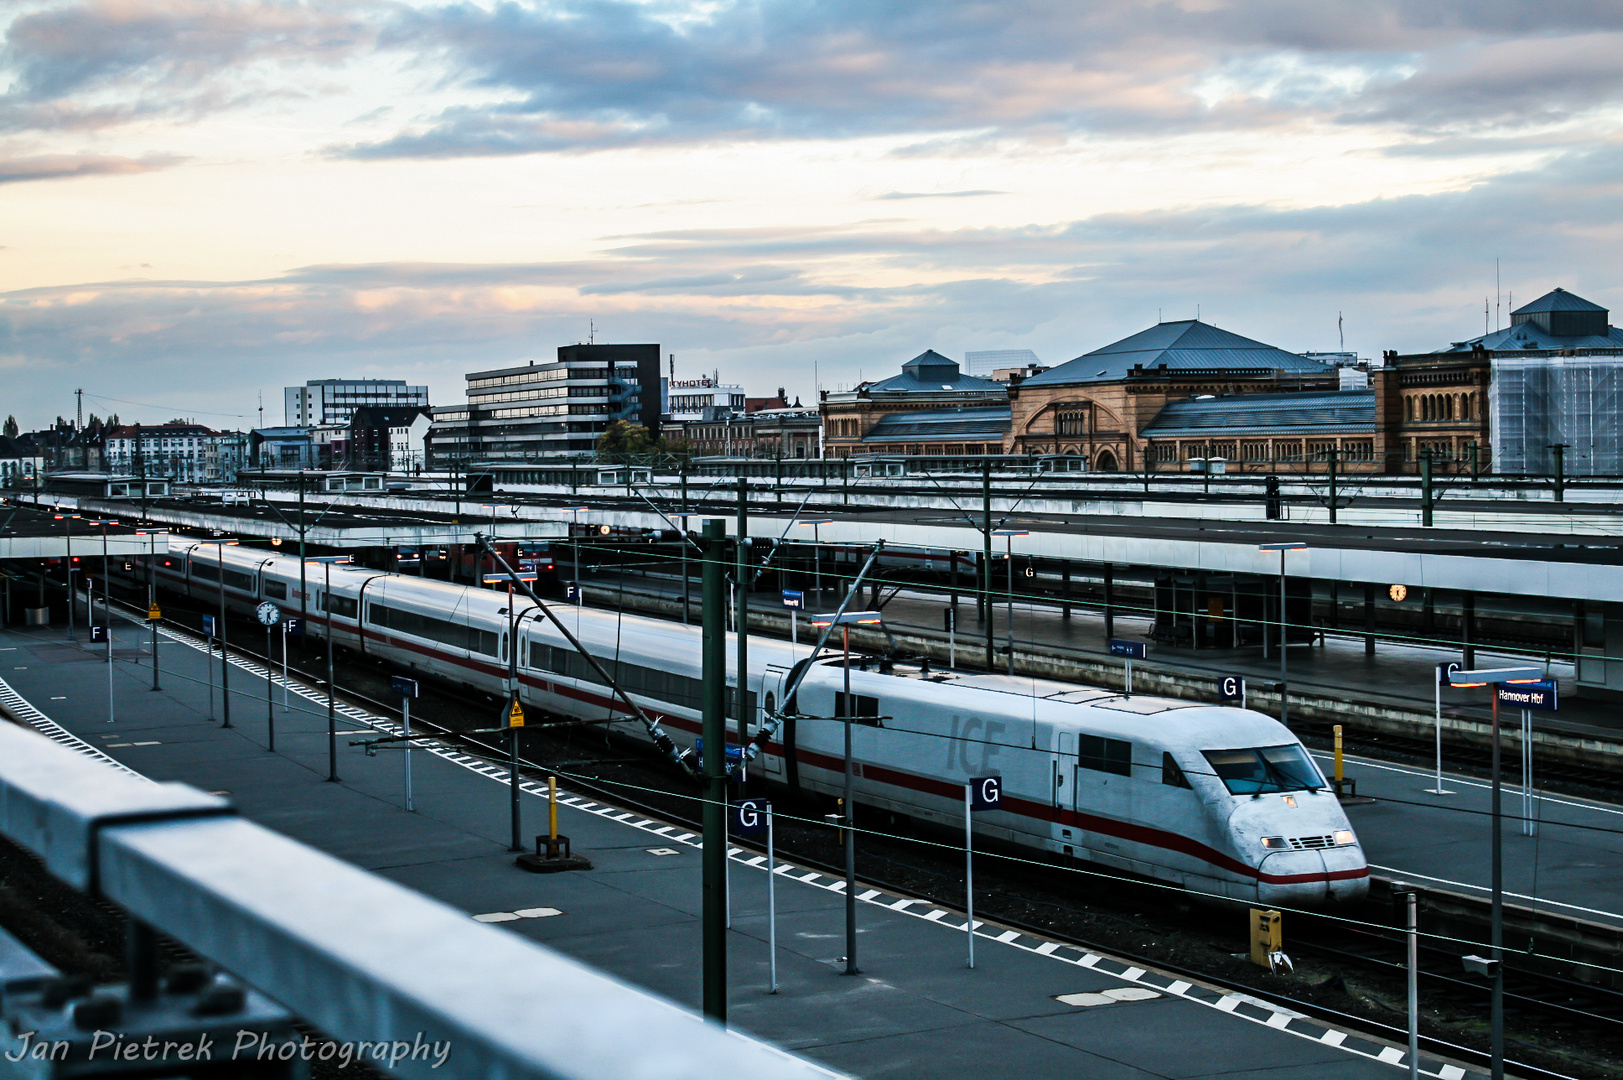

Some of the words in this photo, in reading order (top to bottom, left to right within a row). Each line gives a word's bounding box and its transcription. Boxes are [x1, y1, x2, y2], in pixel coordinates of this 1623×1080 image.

[1025, 567, 1034, 576] G
[567, 586, 574, 598] F
[92, 627, 100, 639] F
[289, 620, 296, 632] F
[1224, 677, 1236, 696] G
[1499, 690, 1530, 702] Hannover
[1531, 693, 1544, 704] Hbf
[947, 715, 1006, 775] ICE
[982, 778, 998, 802] G
[740, 802, 758, 826] G
